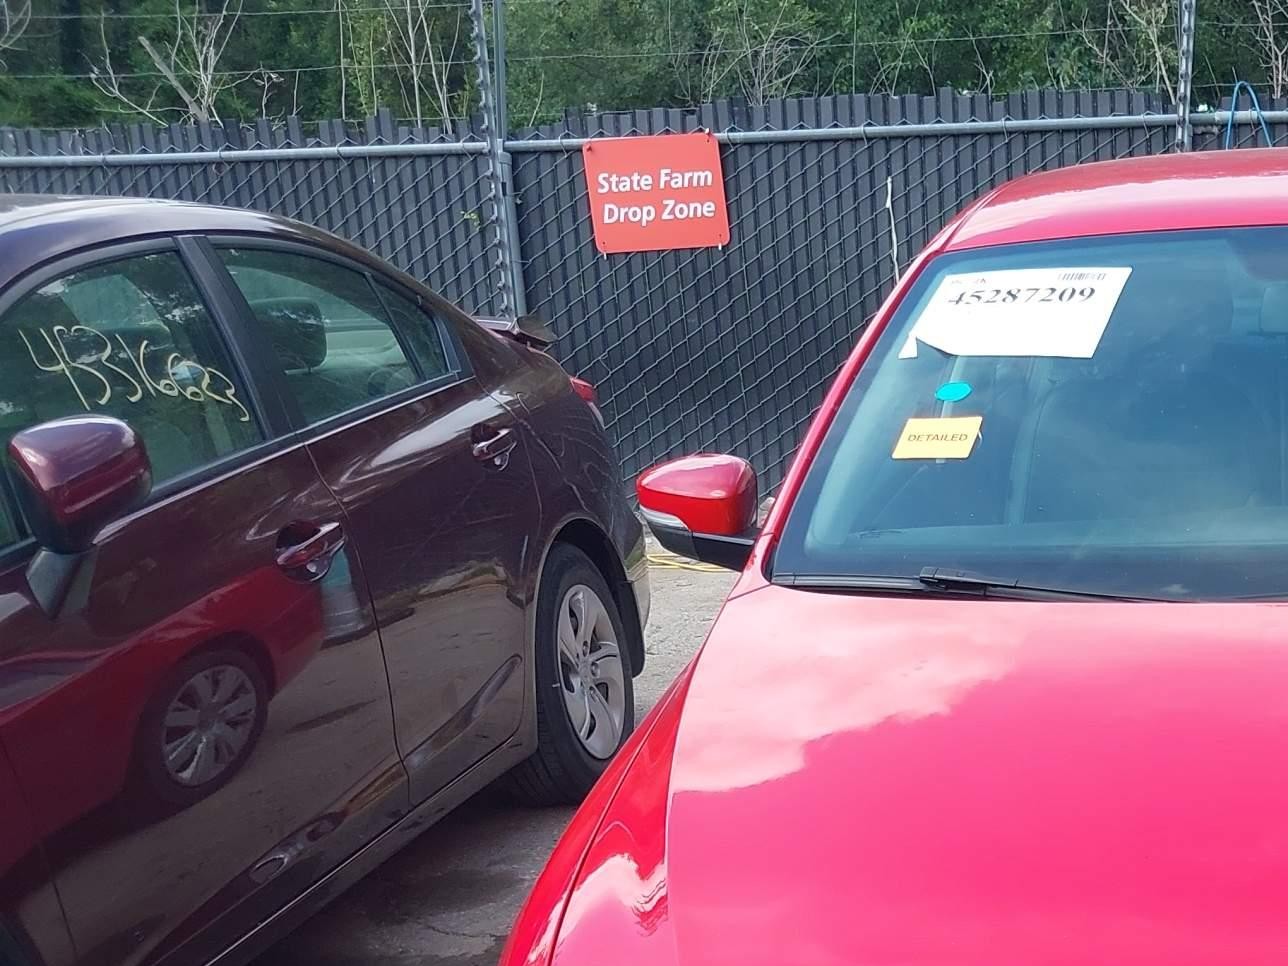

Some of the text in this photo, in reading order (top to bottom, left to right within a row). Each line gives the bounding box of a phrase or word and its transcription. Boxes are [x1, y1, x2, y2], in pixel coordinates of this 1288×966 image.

[597, 168, 713, 194] State Farm
[603, 199, 716, 227] Drop Zone
[948, 286, 1096, 305] 45287209
[907, 433, 968, 442] DETAILED
